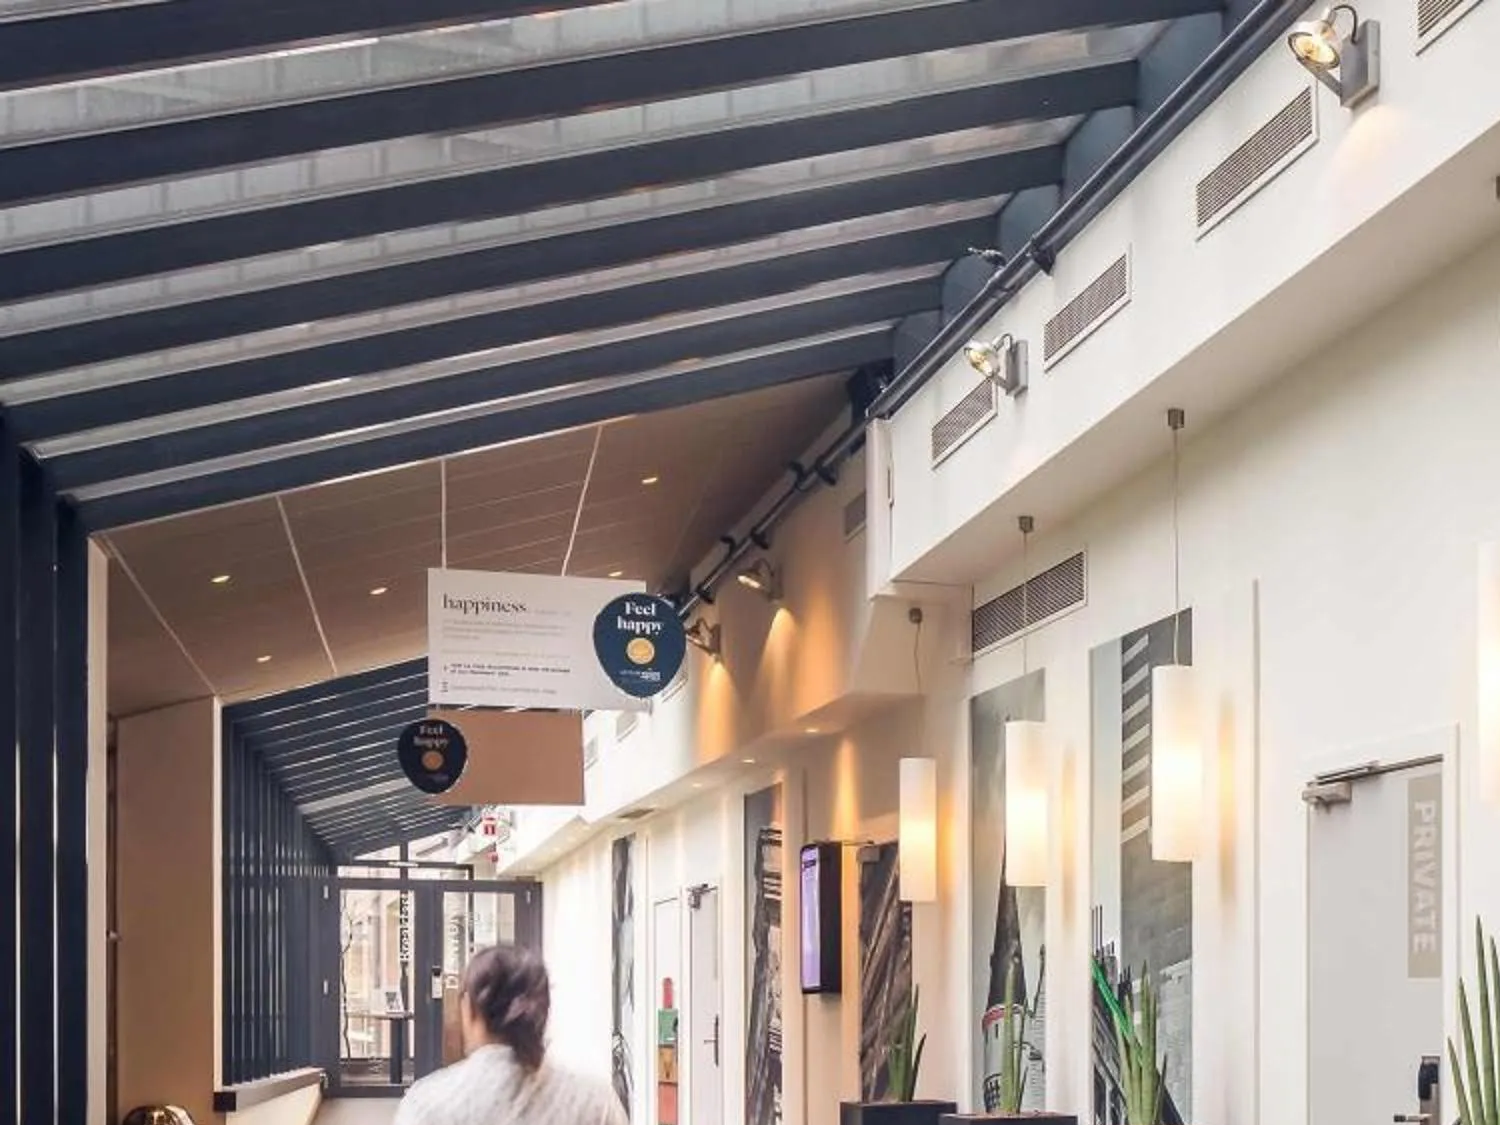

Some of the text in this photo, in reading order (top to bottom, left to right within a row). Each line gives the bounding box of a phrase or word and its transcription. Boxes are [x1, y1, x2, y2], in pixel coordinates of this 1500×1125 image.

[443, 592, 527, 615] happiness
[625, 601, 655, 616] Feel
[617, 615, 664, 635] happy
[1413, 800, 1437, 953] PRIVATE
